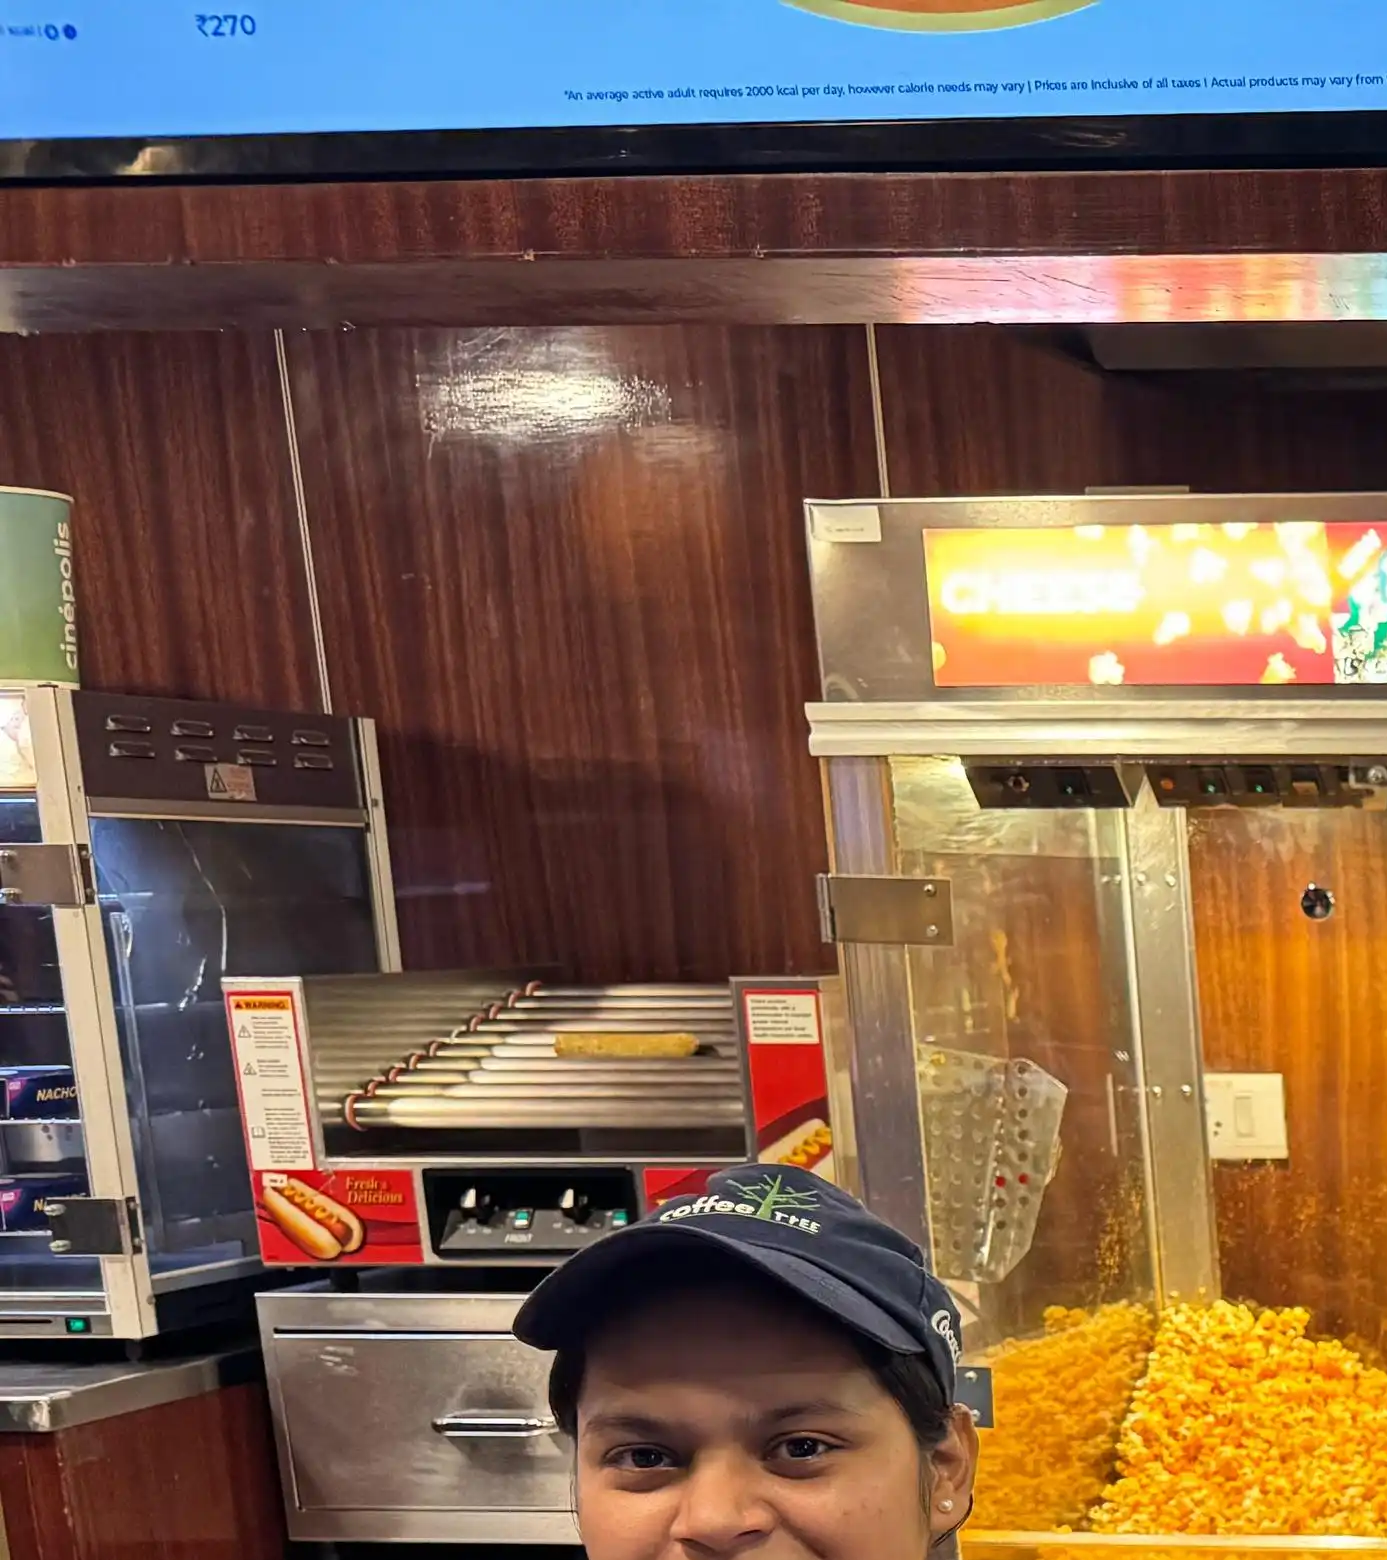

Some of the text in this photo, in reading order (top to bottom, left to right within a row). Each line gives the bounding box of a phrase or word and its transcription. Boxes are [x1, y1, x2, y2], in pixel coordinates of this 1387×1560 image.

[195, 14, 257, 38] ₹270
[667, 86, 695, 99] adult
[746, 85, 774, 97] 2000
[776, 84, 799, 96] kcal
[974, 83, 998, 95] may
[1001, 82, 1024, 94] vary
[1211, 76, 1246, 88] Actual
[1249, 75, 1299, 88] products
[1301, 77, 1326, 88] may
[1329, 75, 1352, 88] vary
[1355, 73, 1384, 86] from
[53, 521, 78, 670] cinépolis
[659, 1194, 755, 1224] coffee
